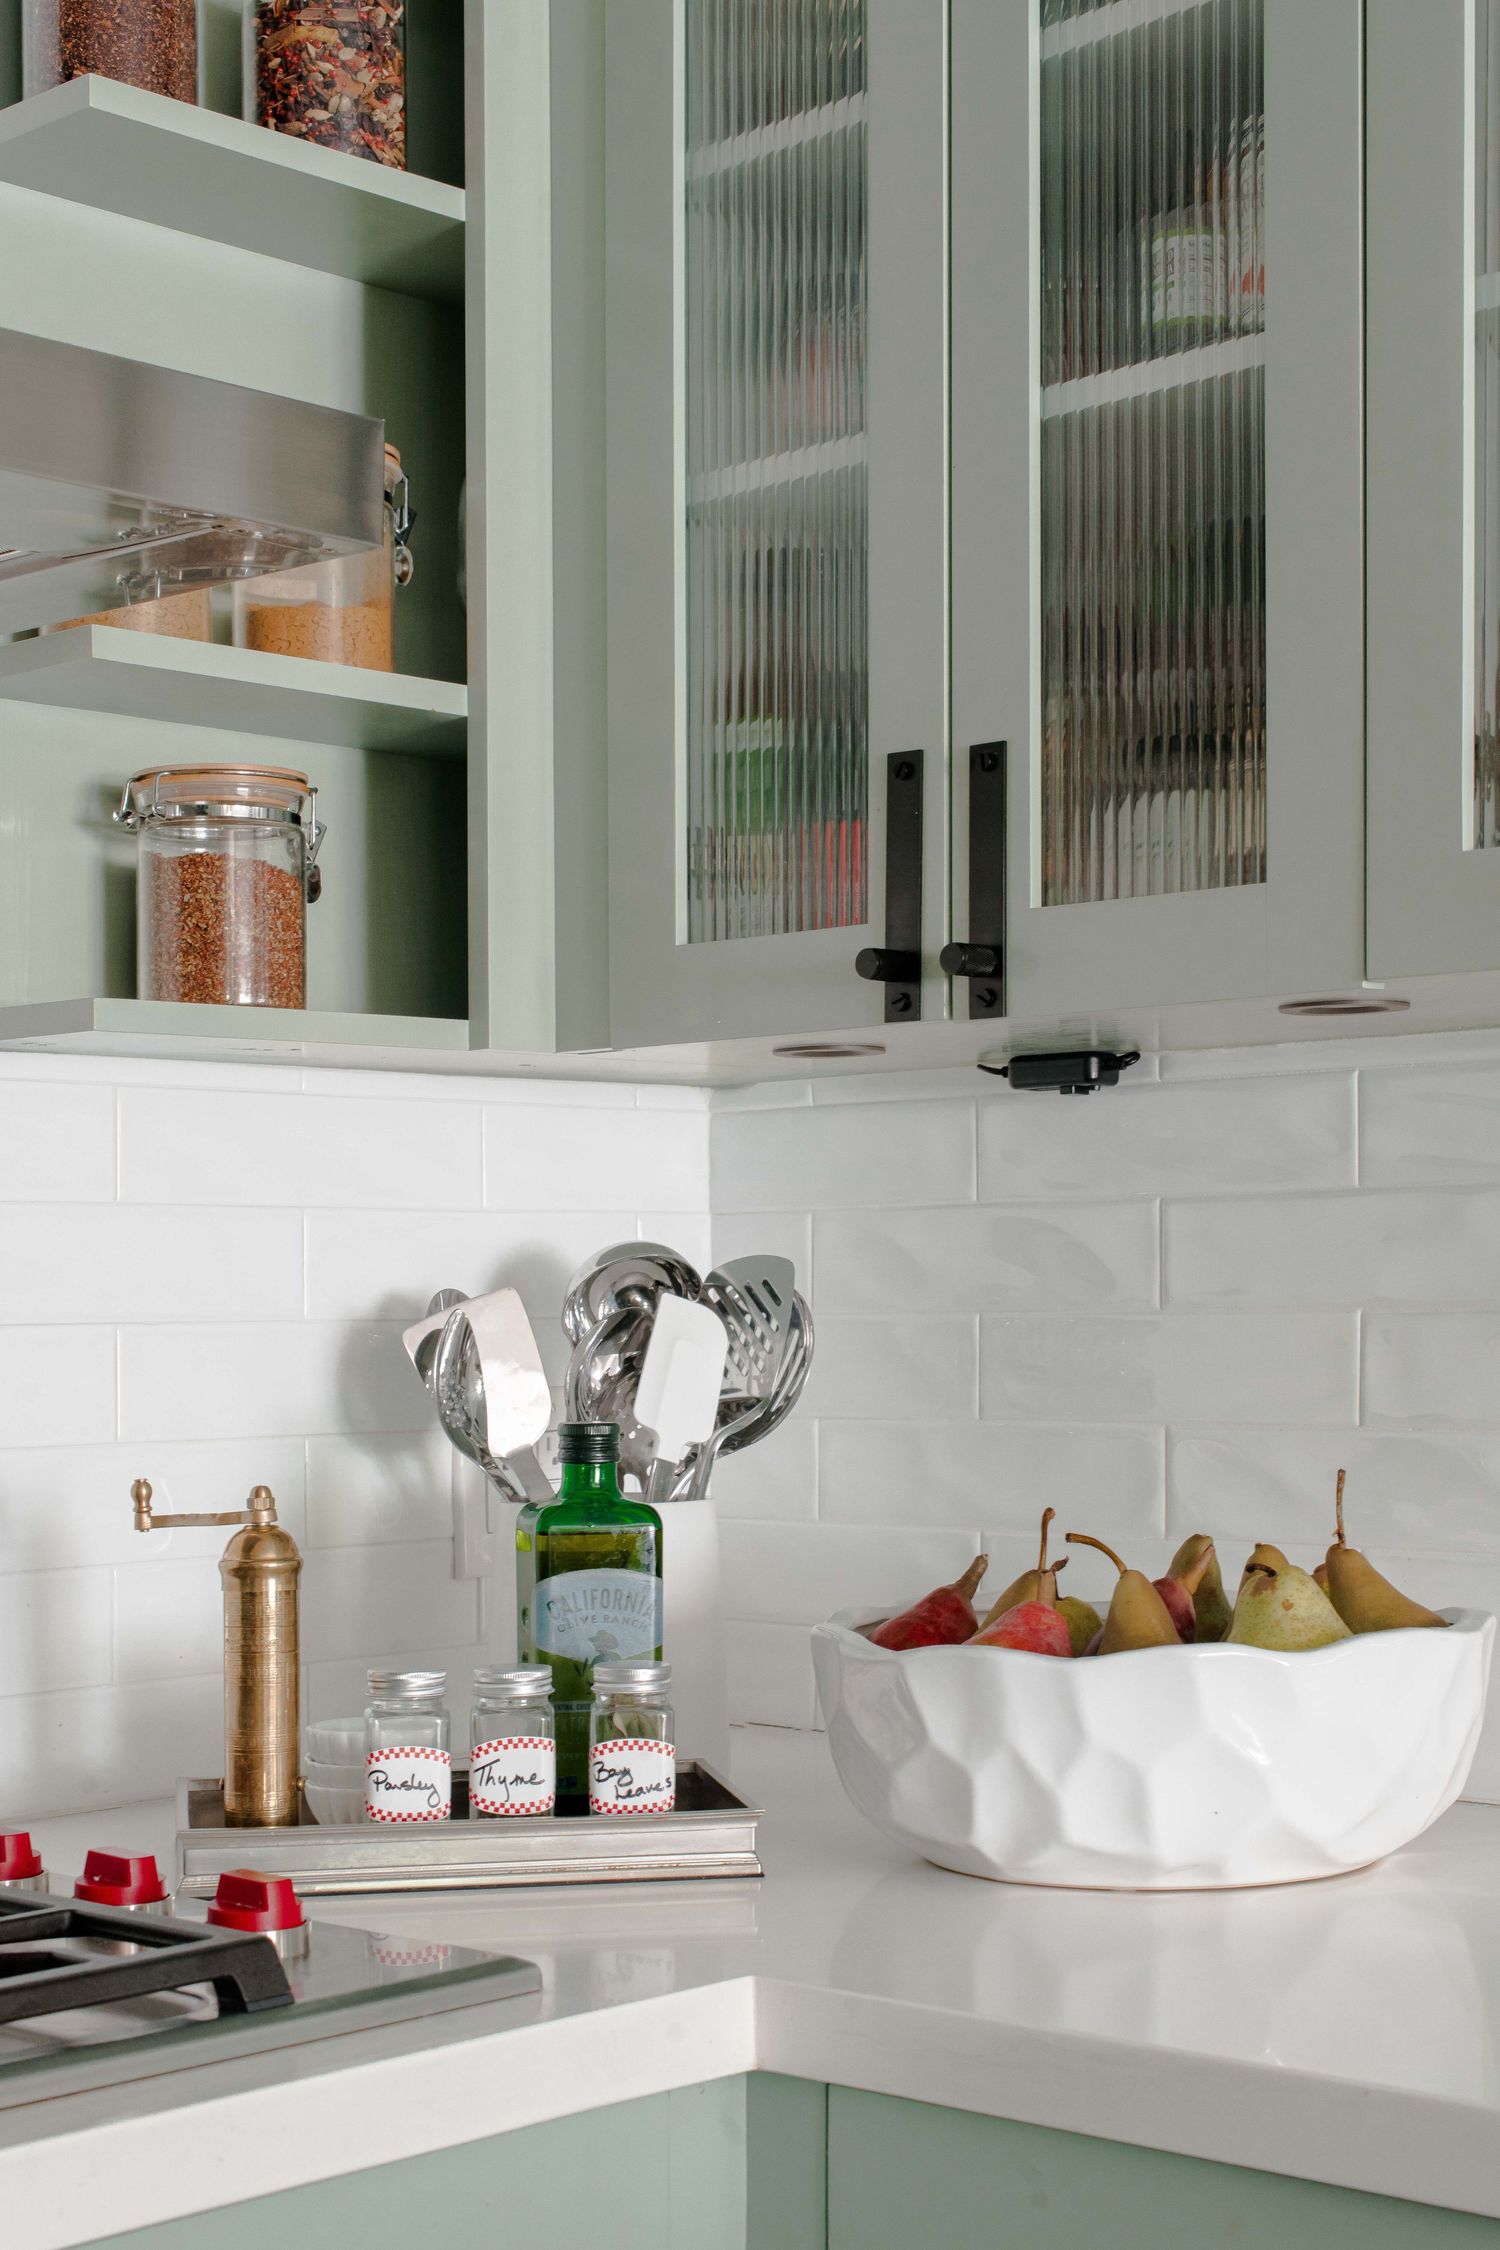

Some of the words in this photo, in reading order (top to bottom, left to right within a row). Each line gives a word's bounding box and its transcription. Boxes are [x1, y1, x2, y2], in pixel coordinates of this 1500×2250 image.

[546, 1588, 653, 1620] CALIFORNIA
[557, 1615, 598, 1633] OLIVE
[603, 1615, 648, 1632] RANCH
[368, 1769, 441, 1808] Parsley
[473, 1758, 545, 1802] Thyme
[593, 1761, 633, 1787] Bay
[614, 1777, 672, 1801] Leaves
